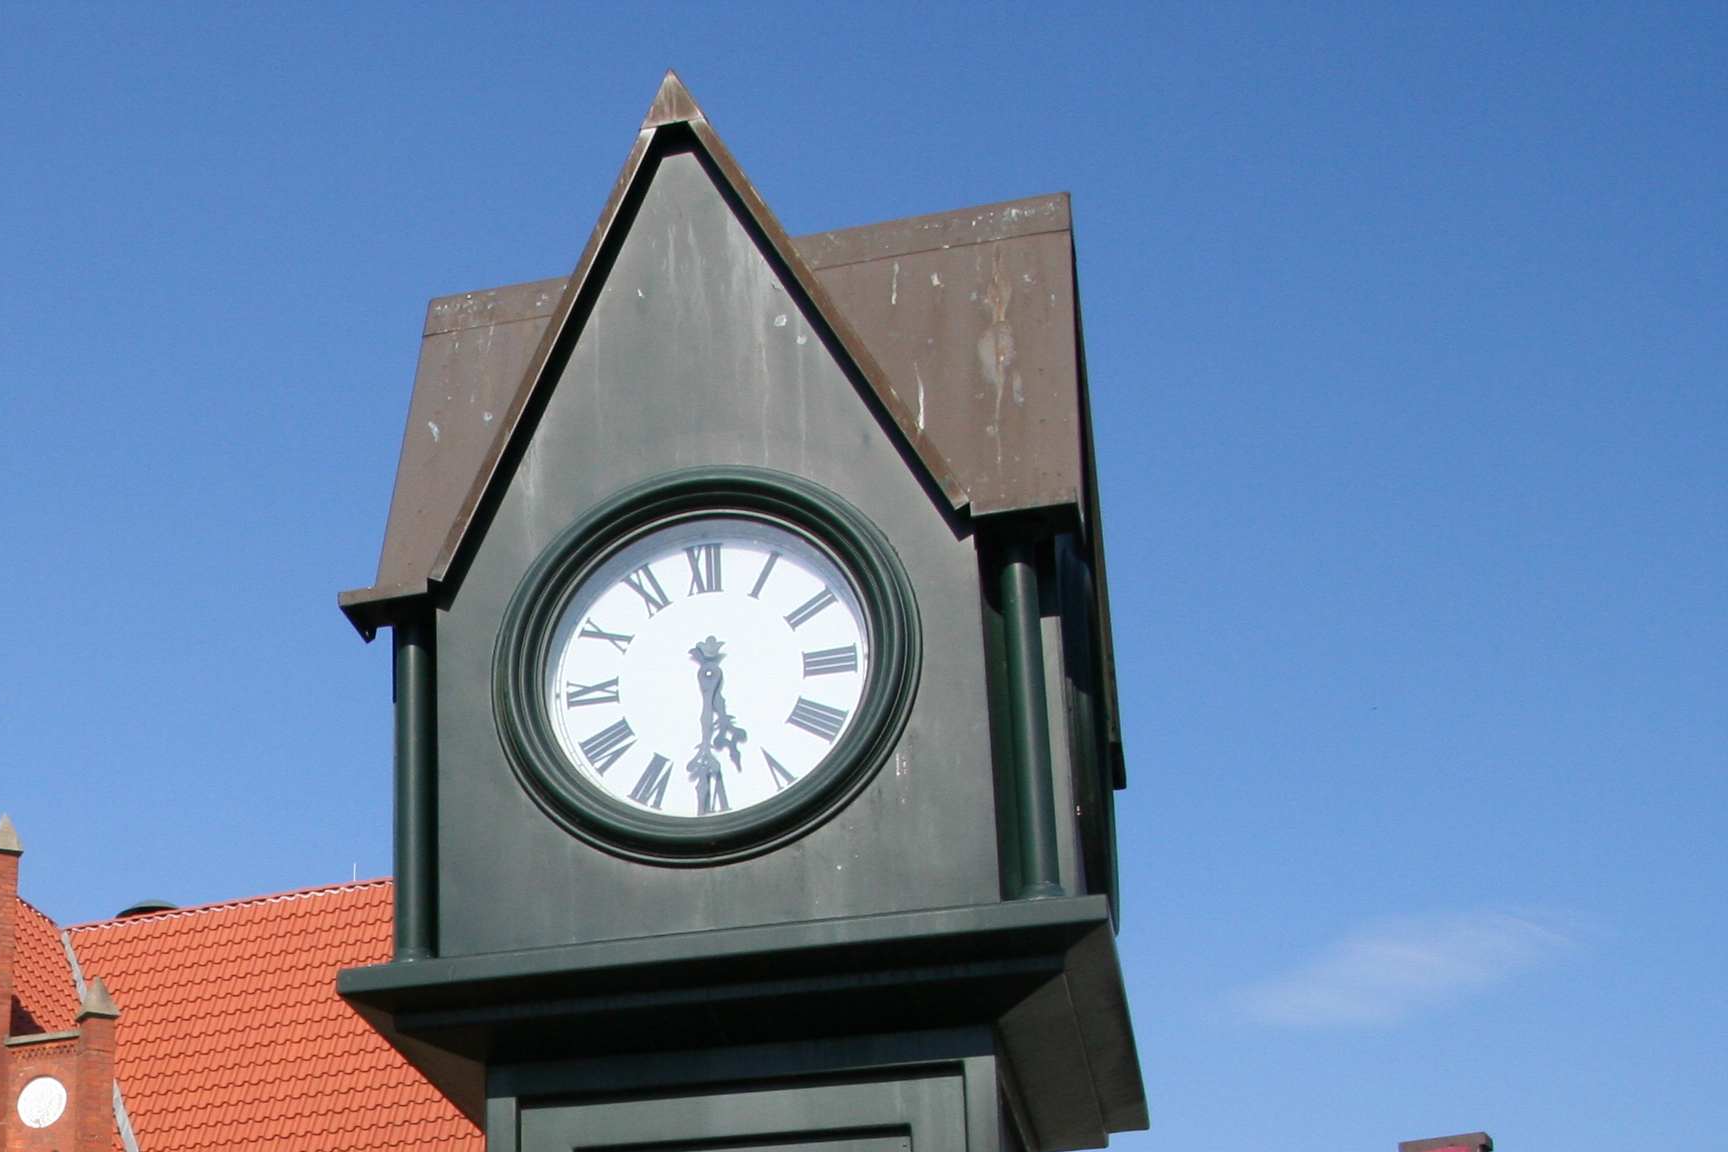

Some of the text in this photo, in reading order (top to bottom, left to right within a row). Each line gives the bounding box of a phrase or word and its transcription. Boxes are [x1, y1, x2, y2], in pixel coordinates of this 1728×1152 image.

[620, 562, 674, 619] XI
[683, 543, 724, 596] XII
[748, 552, 782, 600] I
[783, 585, 840, 632] II
[578, 617, 635, 655] X
[802, 643, 858, 679] III
[566, 676, 620, 710] IX
[785, 695, 850, 744] IIII
[578, 716, 640, 777] VIII
[759, 745, 799, 793] V
[626, 751, 674, 811] VII
